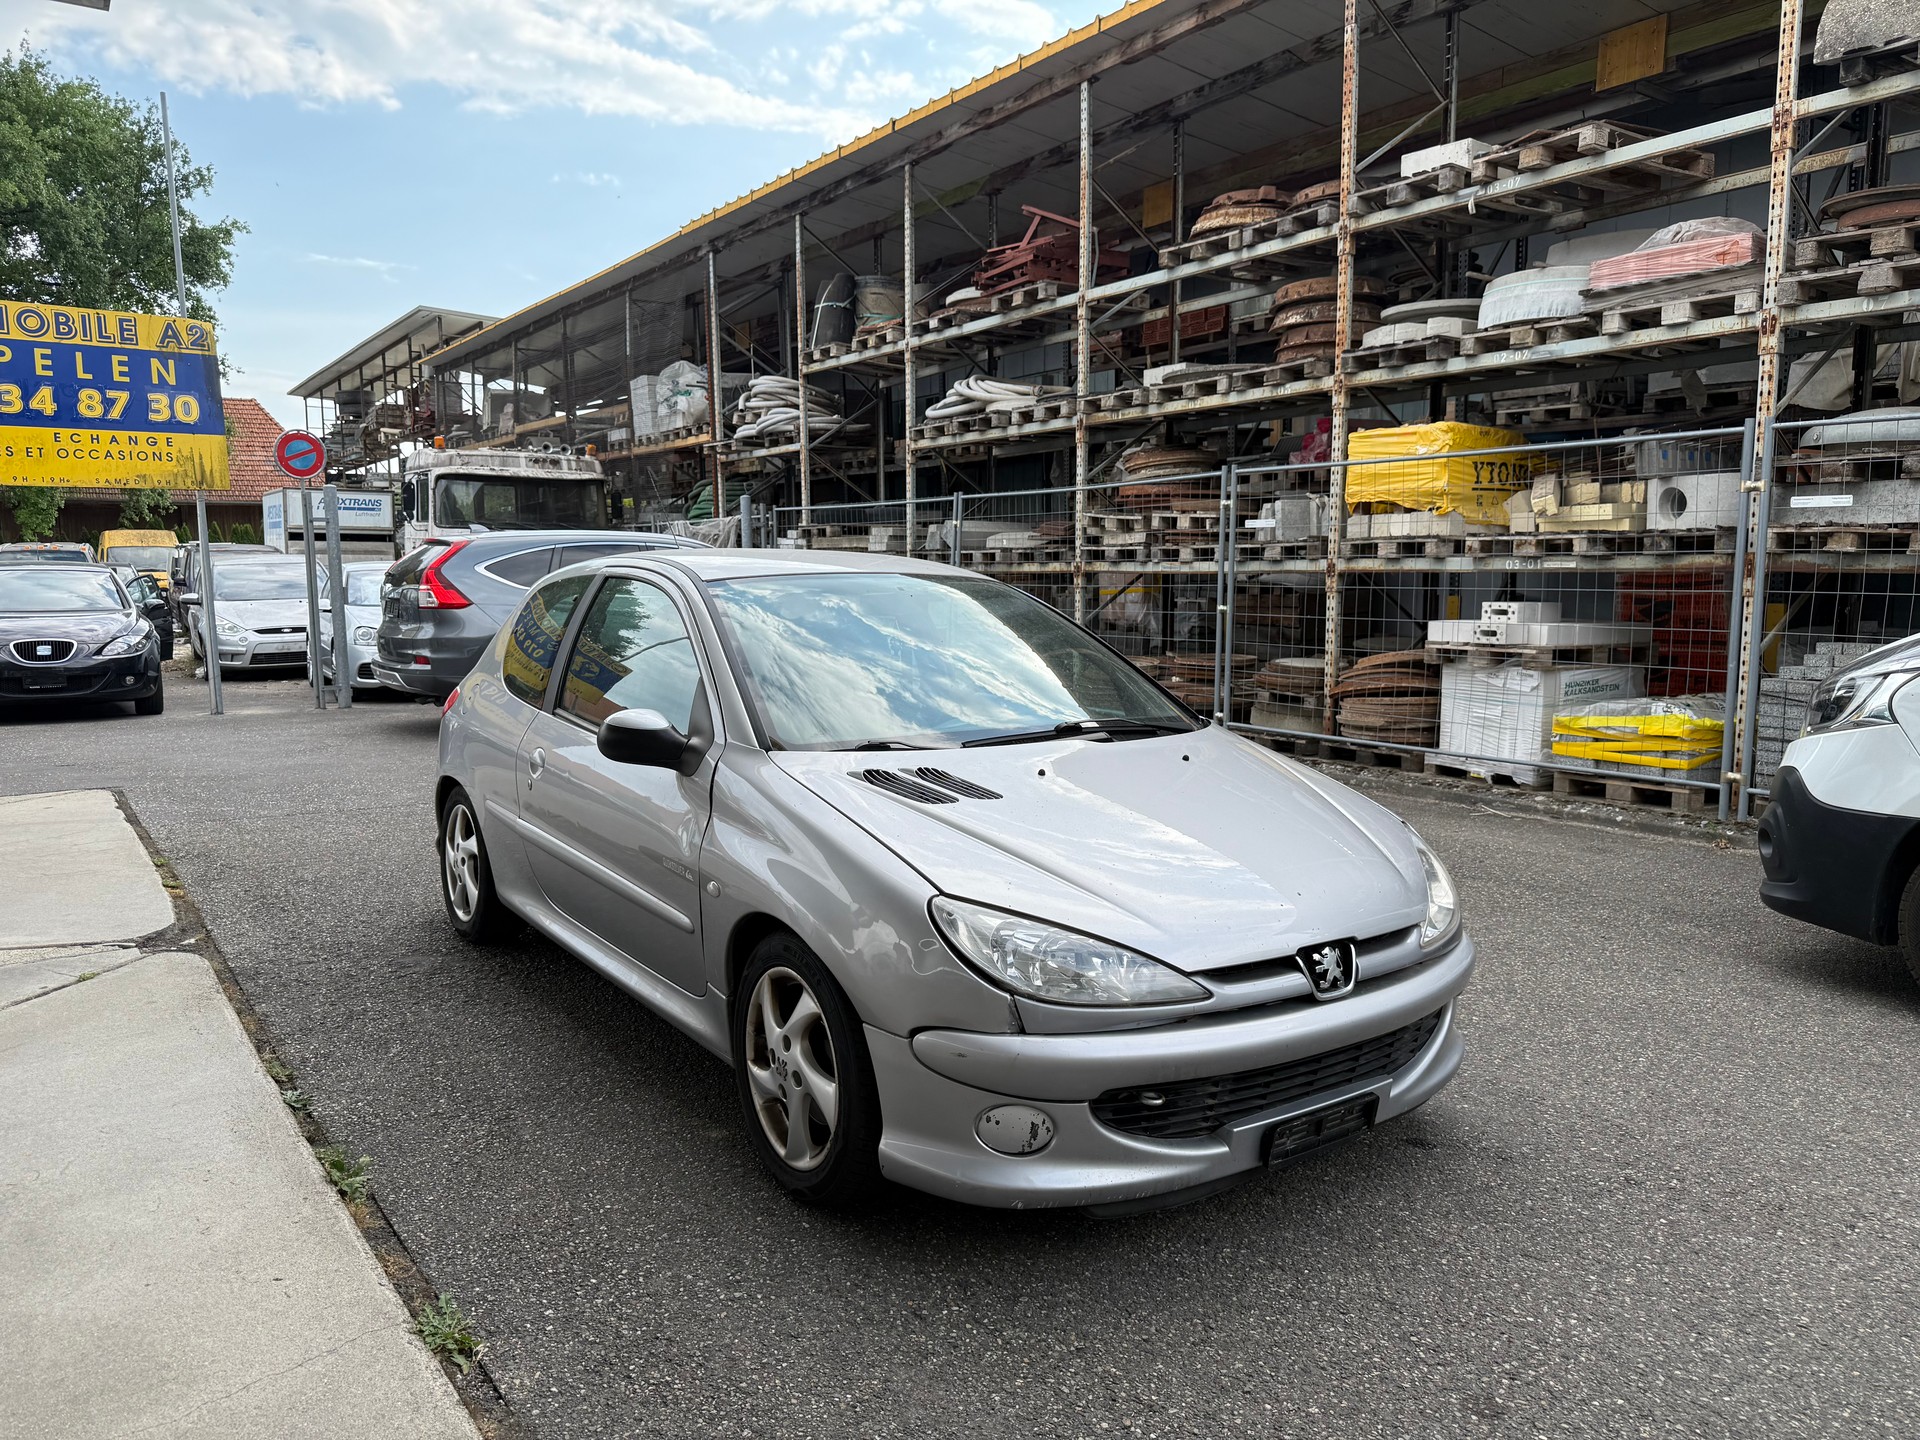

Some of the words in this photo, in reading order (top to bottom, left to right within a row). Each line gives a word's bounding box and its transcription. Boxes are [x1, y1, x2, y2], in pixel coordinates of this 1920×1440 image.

[155, 319, 211, 351] A2
[77, 388, 130, 420] 87
[147, 392, 200, 424] 30
[53, 432, 174, 448] ECHANGE
[0, 445, 14, 456] S
[25, 447, 44, 457] ET
[56, 448, 174, 463] OCCASIONS
[95, 478, 148, 486] SAMEDI
[1563, 683, 1620, 697] KALKSANDSTEIN
[1564, 678, 1600, 690] HUNZIKER
